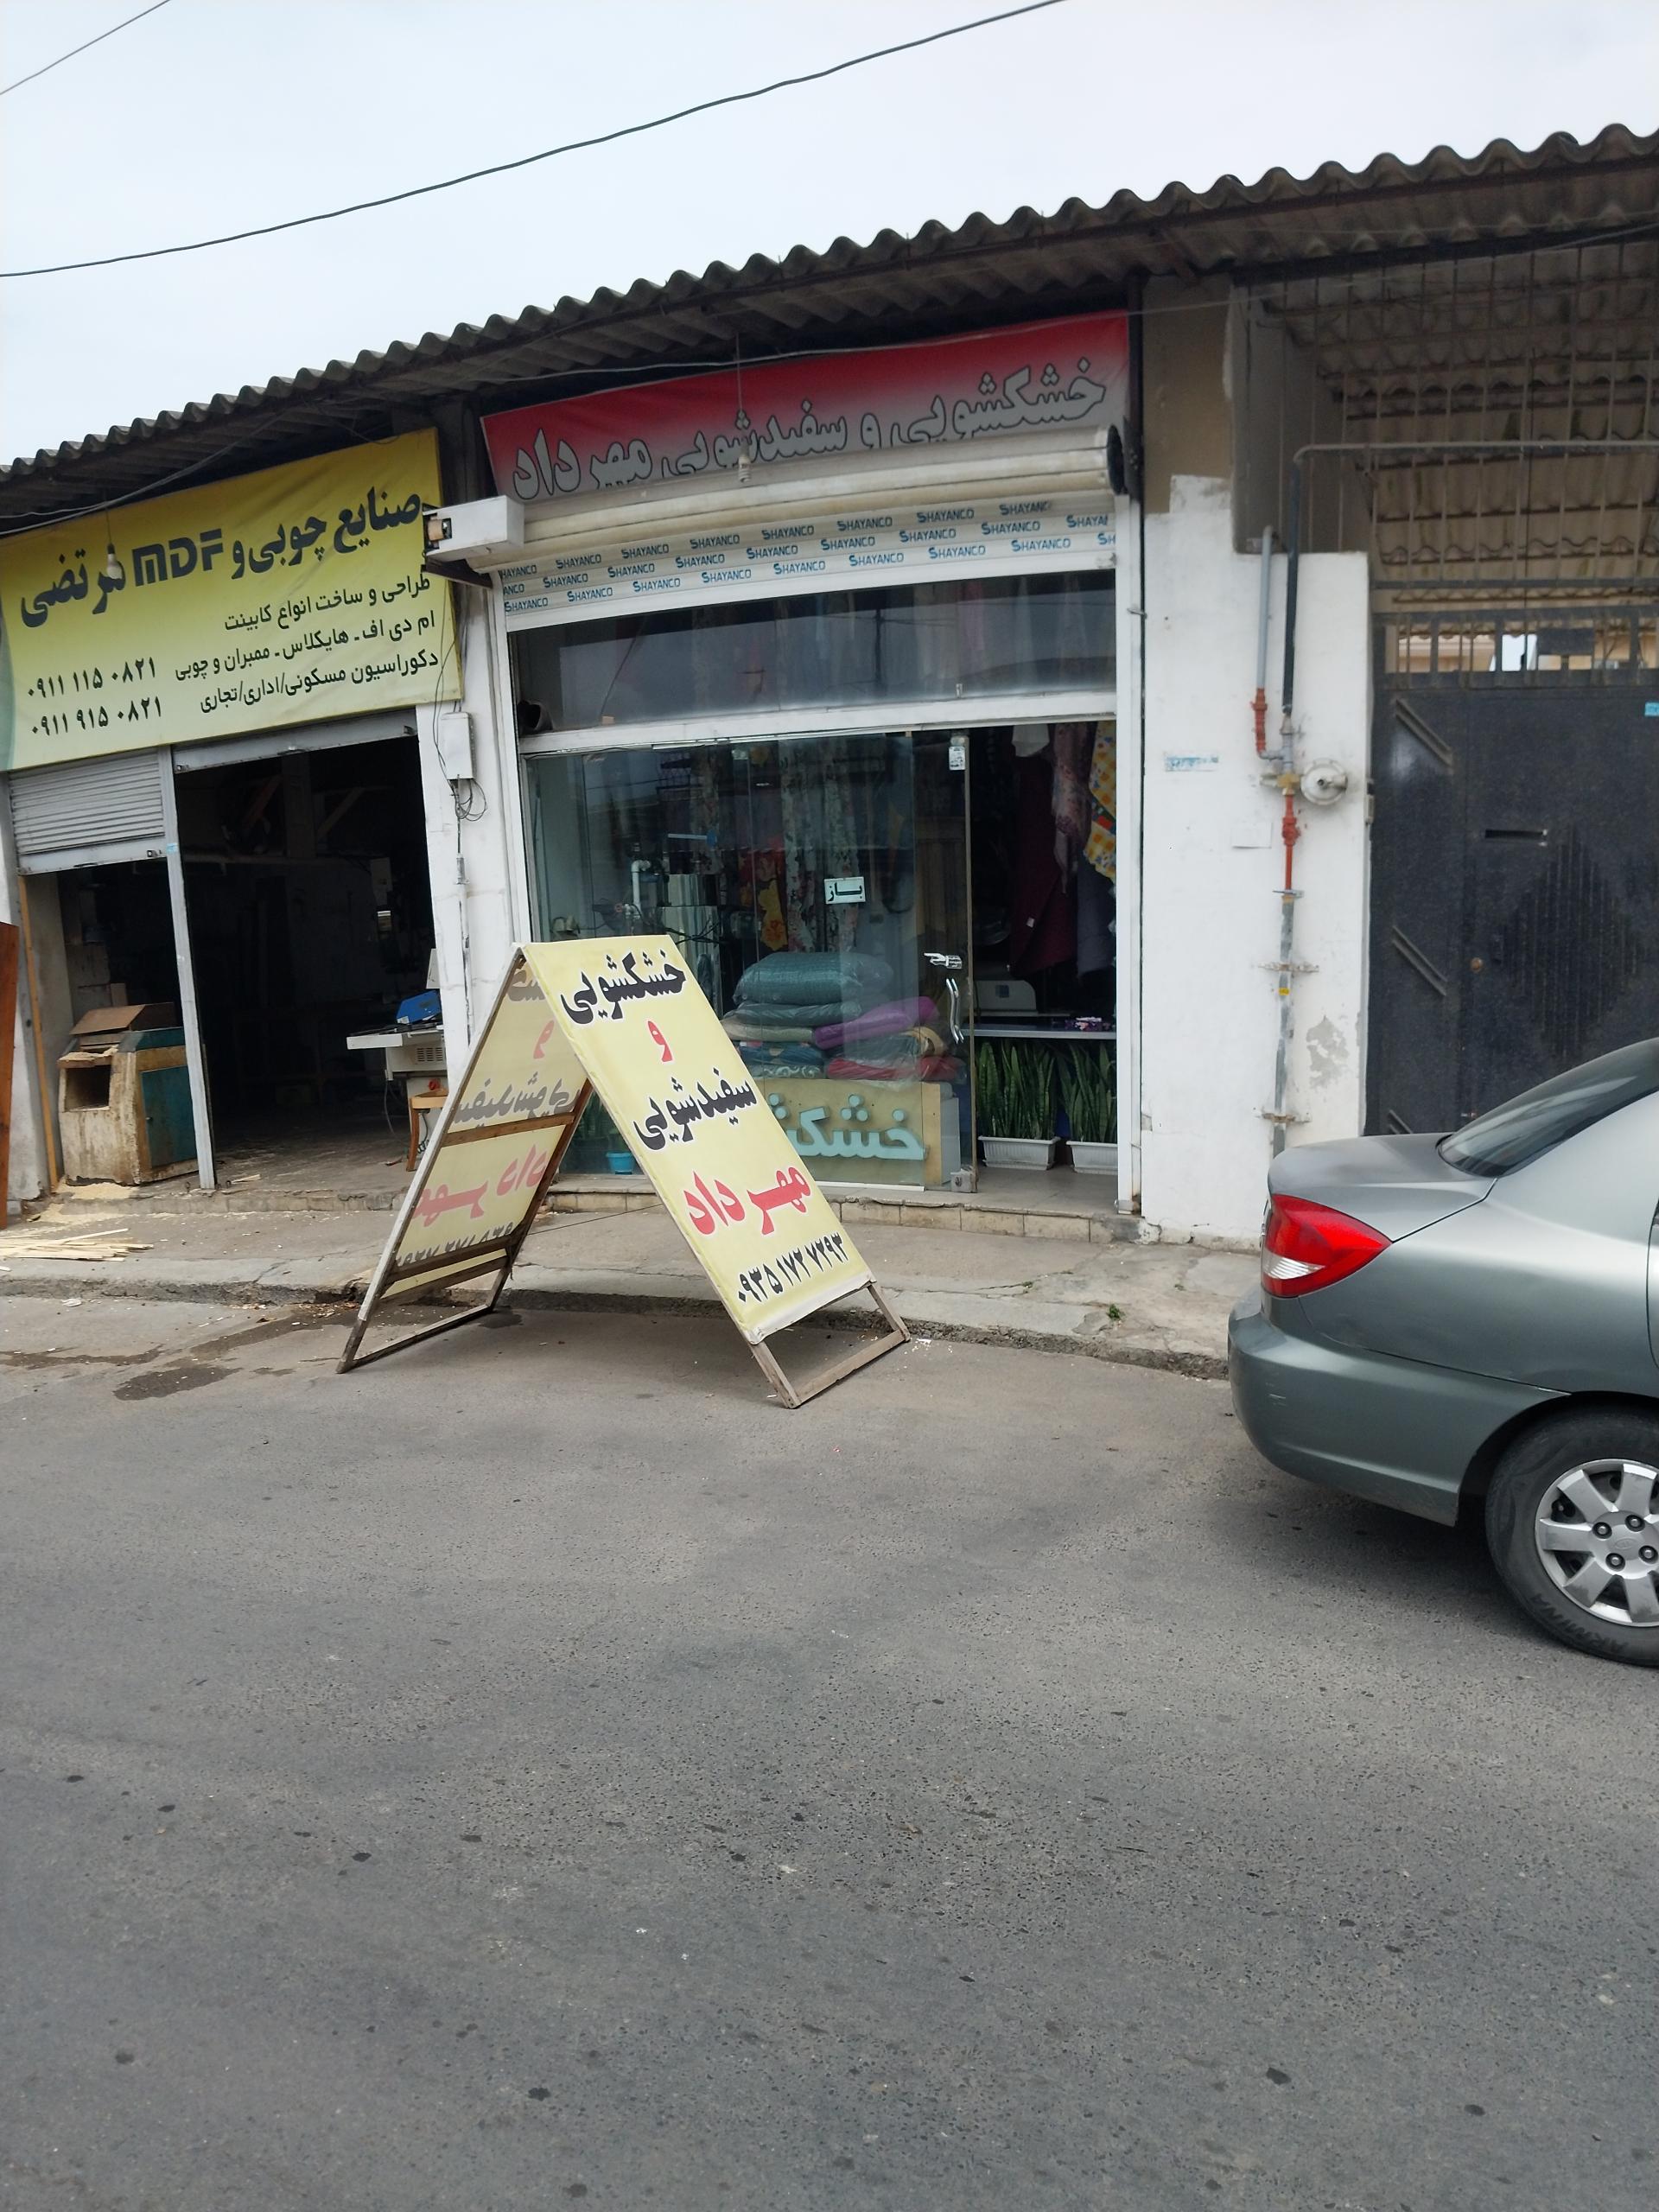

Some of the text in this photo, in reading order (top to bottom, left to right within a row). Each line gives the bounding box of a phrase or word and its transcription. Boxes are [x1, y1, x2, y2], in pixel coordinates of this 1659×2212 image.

[890, 356, 1106, 445] خشکشویی
[860, 412, 882, 449] و
[21, 486, 421, 628] صنایع چوبی و MDF مرتضی
[543, 573, 588, 588] SHAYANCO
[607, 563, 655, 578] SHAYANCO
[675, 554, 725, 569] SHAYANCO
[747, 545, 798, 559] SHAYANCO
[821, 536, 875, 550] SHAYANCO
[899, 528, 957, 543] SHAYANCO
[981, 520, 1041, 535] SHAYANCO
[556, 554, 602, 569] SHAYANCO
[621, 543, 670, 559] SHAYANCO
[690, 534, 741, 550] SHAYANCO
[761, 525, 815, 541] SHAYANCO
[836, 517, 893, 531] SHAYANCO
[917, 508, 975, 523] SHAYANCO
[504, 538, 1071, 612] SHAYANCO SHAYANCO SHAYANCO SHAYANCO SHAYANCO SHAYANCO SHAYANCO SHAYANCO
[225, 573, 430, 632] طراحی و ساخت انواع کابینت
[362, 619, 385, 639] اف
[389, 618, 412, 642] دی
[417, 610, 435, 636] ام
[224, 645, 270, 672] ممبران
[283, 628, 349, 661] هایکلاس
[175, 657, 209, 682] چوبی
[213, 657, 220, 675] و
[351, 648, 439, 684] دکوراسیون
[826, 881, 863, 902] باز
[561, 949, 686, 1025] خشکشویی
[647, 1020, 673, 1062] و
[632, 1067, 757, 1151] سفیدشویی
